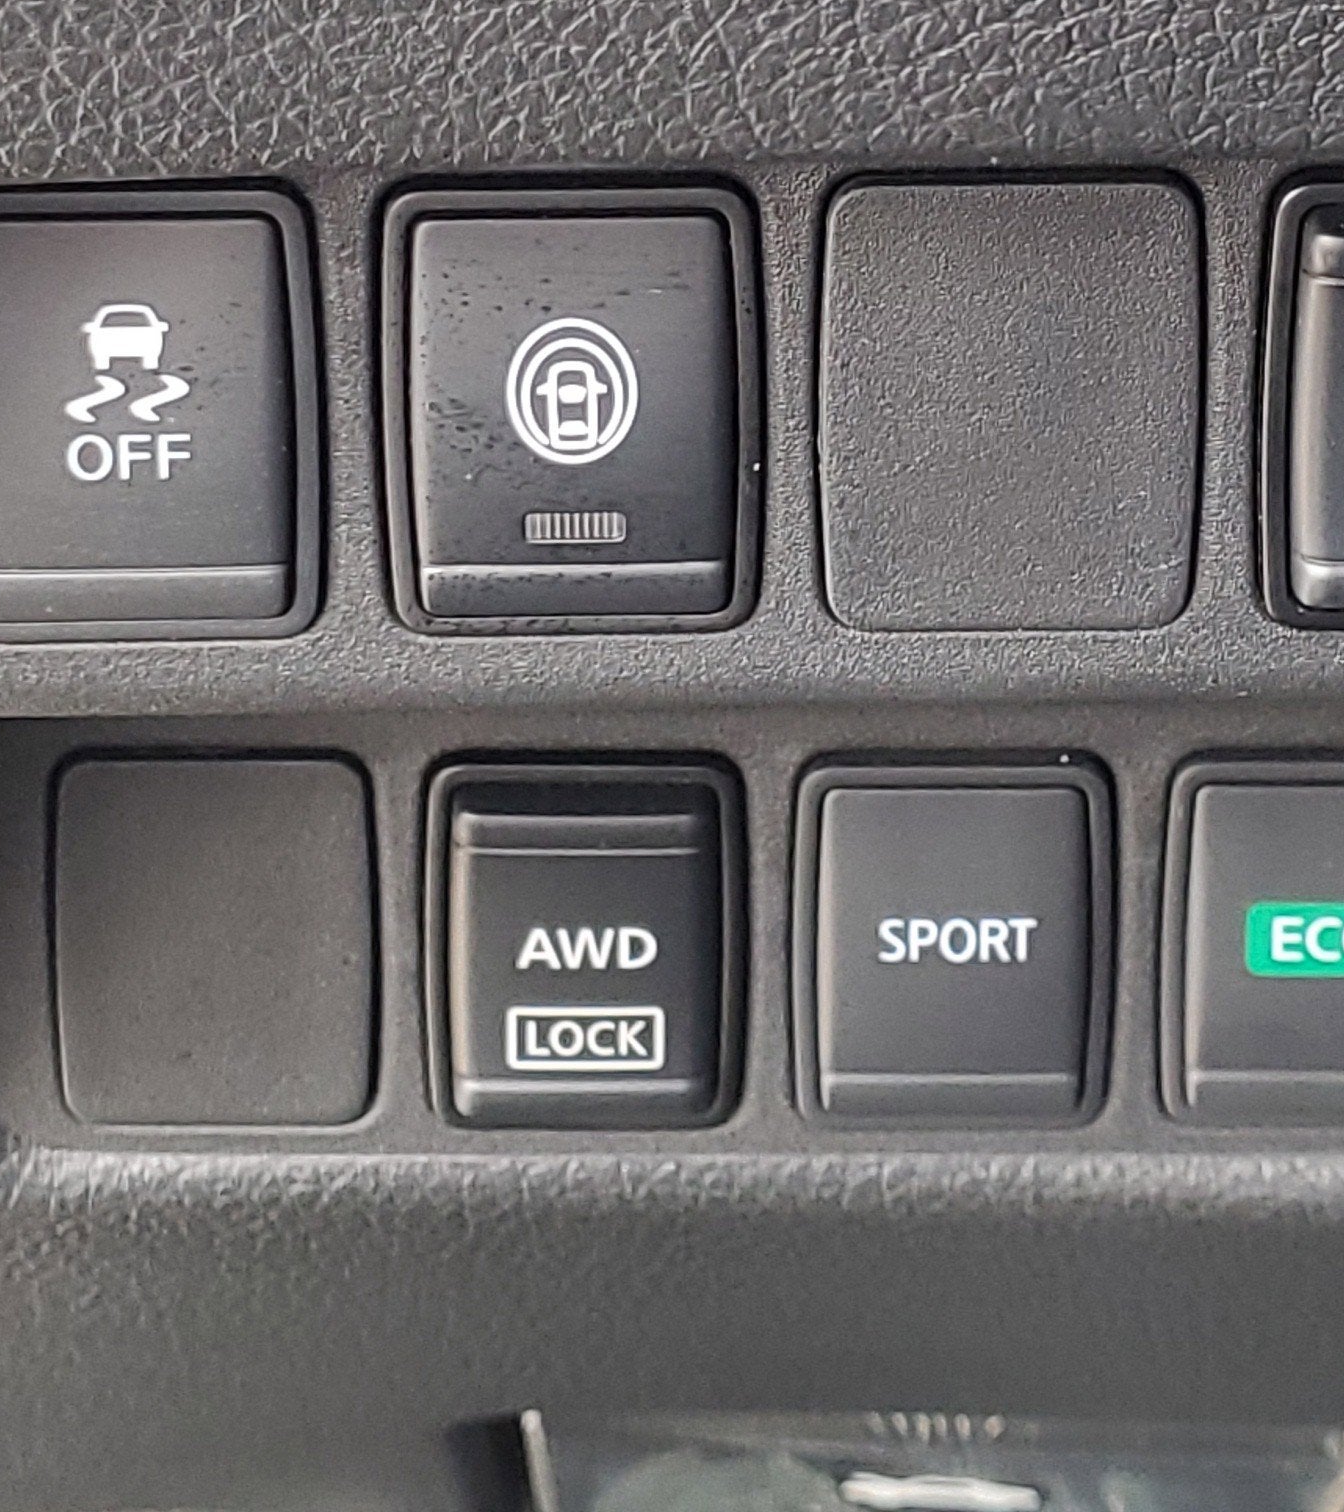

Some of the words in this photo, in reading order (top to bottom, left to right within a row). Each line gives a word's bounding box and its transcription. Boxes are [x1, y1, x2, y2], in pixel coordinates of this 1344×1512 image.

[66, 434, 192, 482] OFF
[515, 927, 658, 970] AWD
[877, 917, 1038, 963] SPORT
[524, 1019, 648, 1057] LOCK
